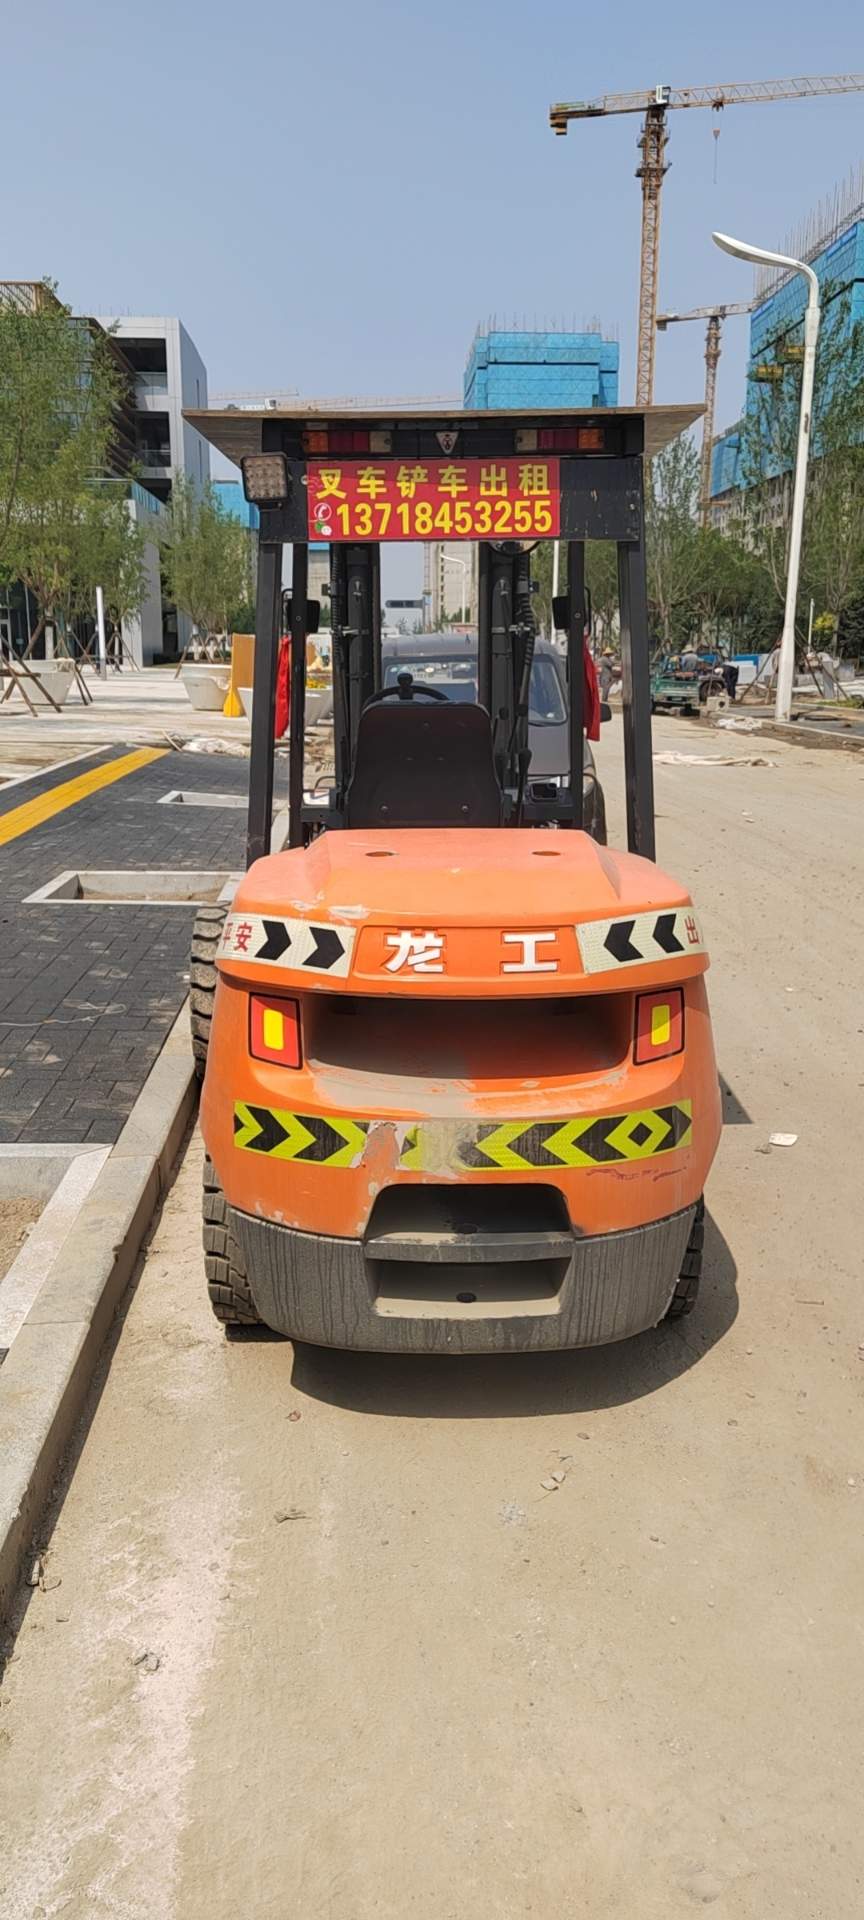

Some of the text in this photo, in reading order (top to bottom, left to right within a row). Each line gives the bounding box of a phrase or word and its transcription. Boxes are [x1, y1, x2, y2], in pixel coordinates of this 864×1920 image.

[316, 464, 551, 499] 叉车铲车出租
[336, 500, 552, 536] 13718453255
[384, 929, 558, 973] 龙工
